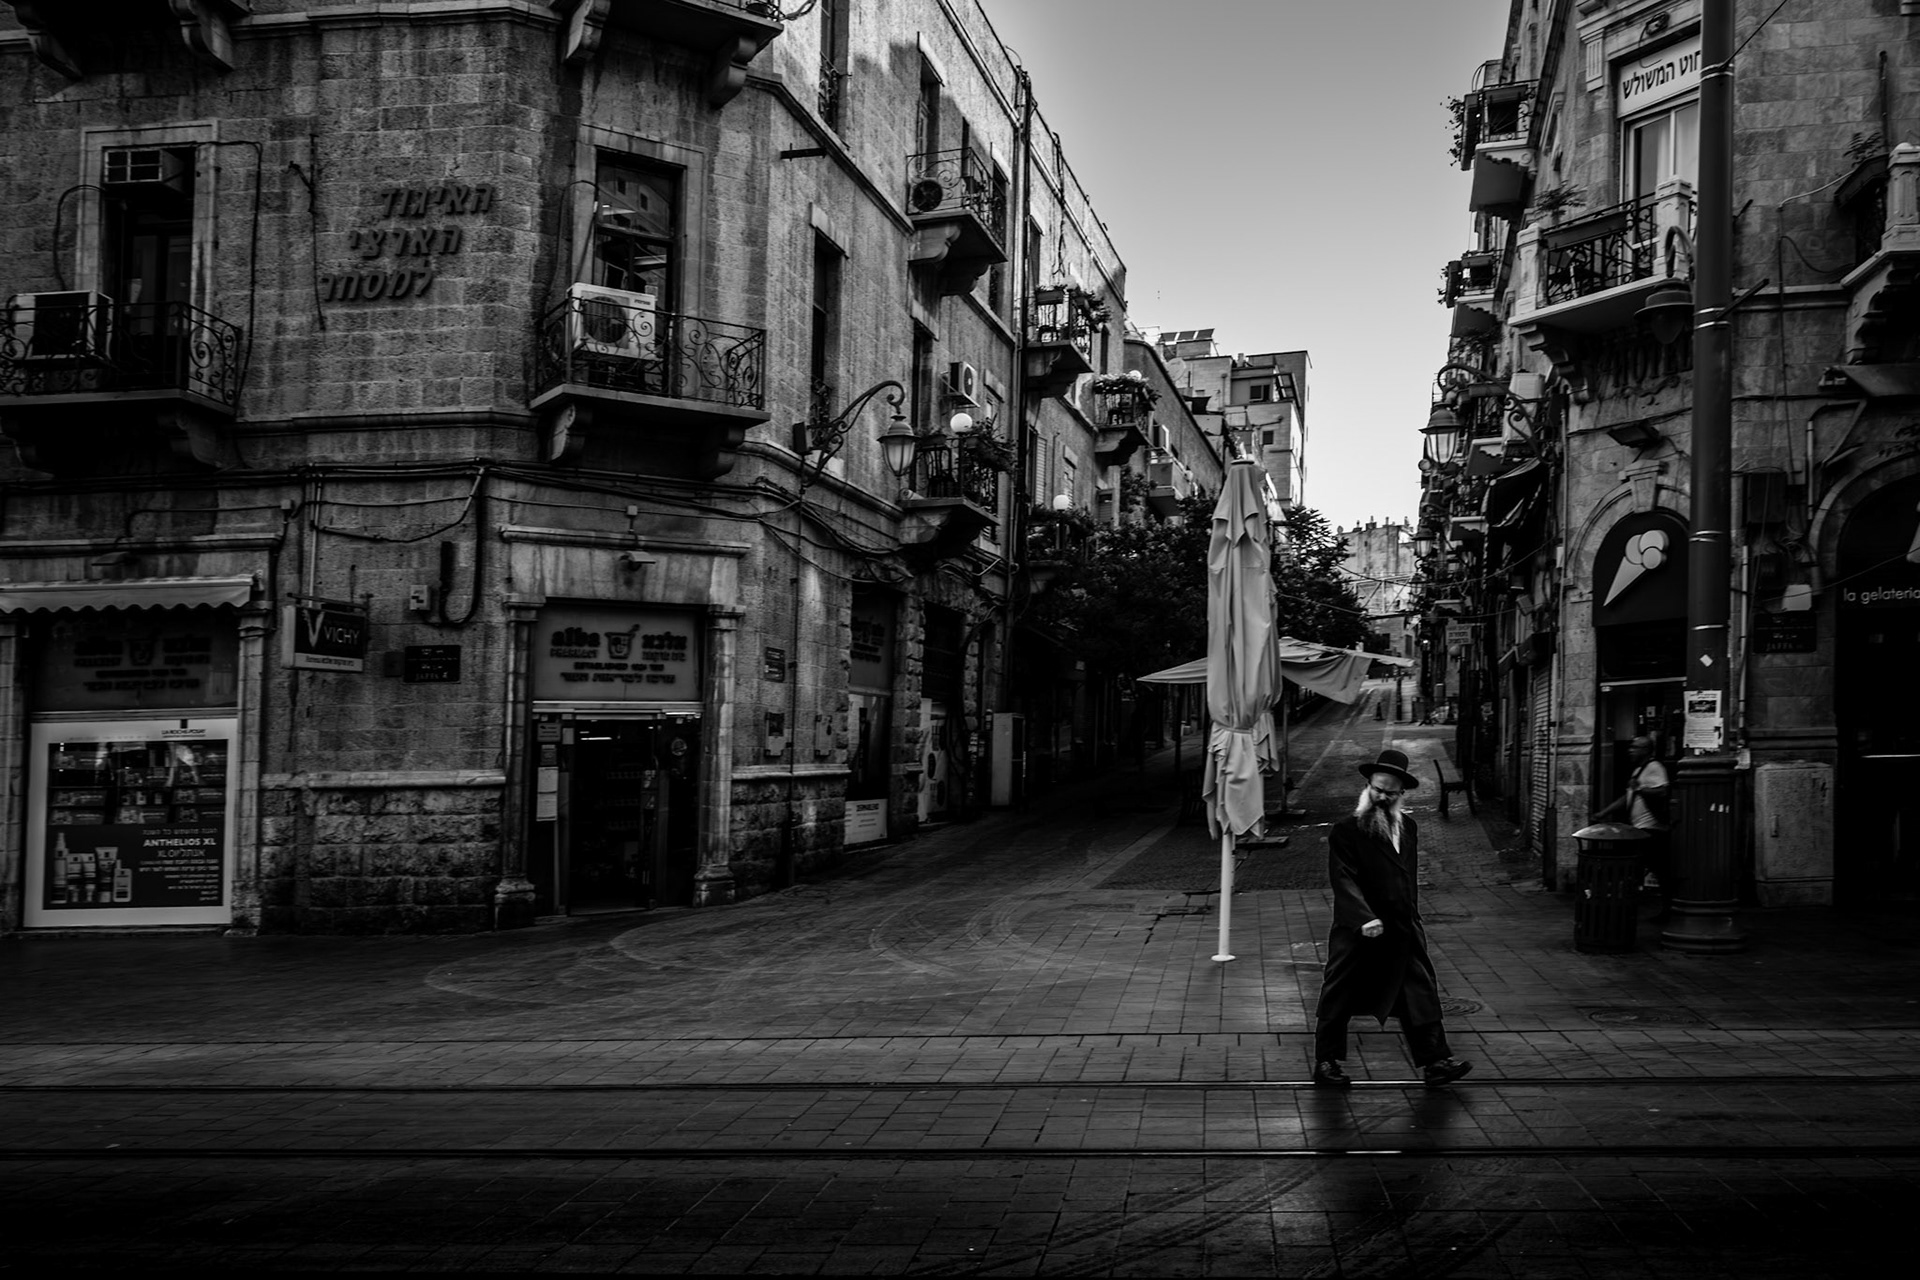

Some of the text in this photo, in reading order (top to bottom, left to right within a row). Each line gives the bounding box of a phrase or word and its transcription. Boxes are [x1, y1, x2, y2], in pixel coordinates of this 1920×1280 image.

[1622, 61, 1675, 99] המשולש
[379, 183, 493, 218] האיגוד
[350, 225, 462, 260] הארצי
[320, 260, 434, 302] למסחר
[1843, 586, 1920, 605] la gelateria
[323, 625, 361, 645] VICHY
[142, 837, 217, 848] ANTHELIOS XL
